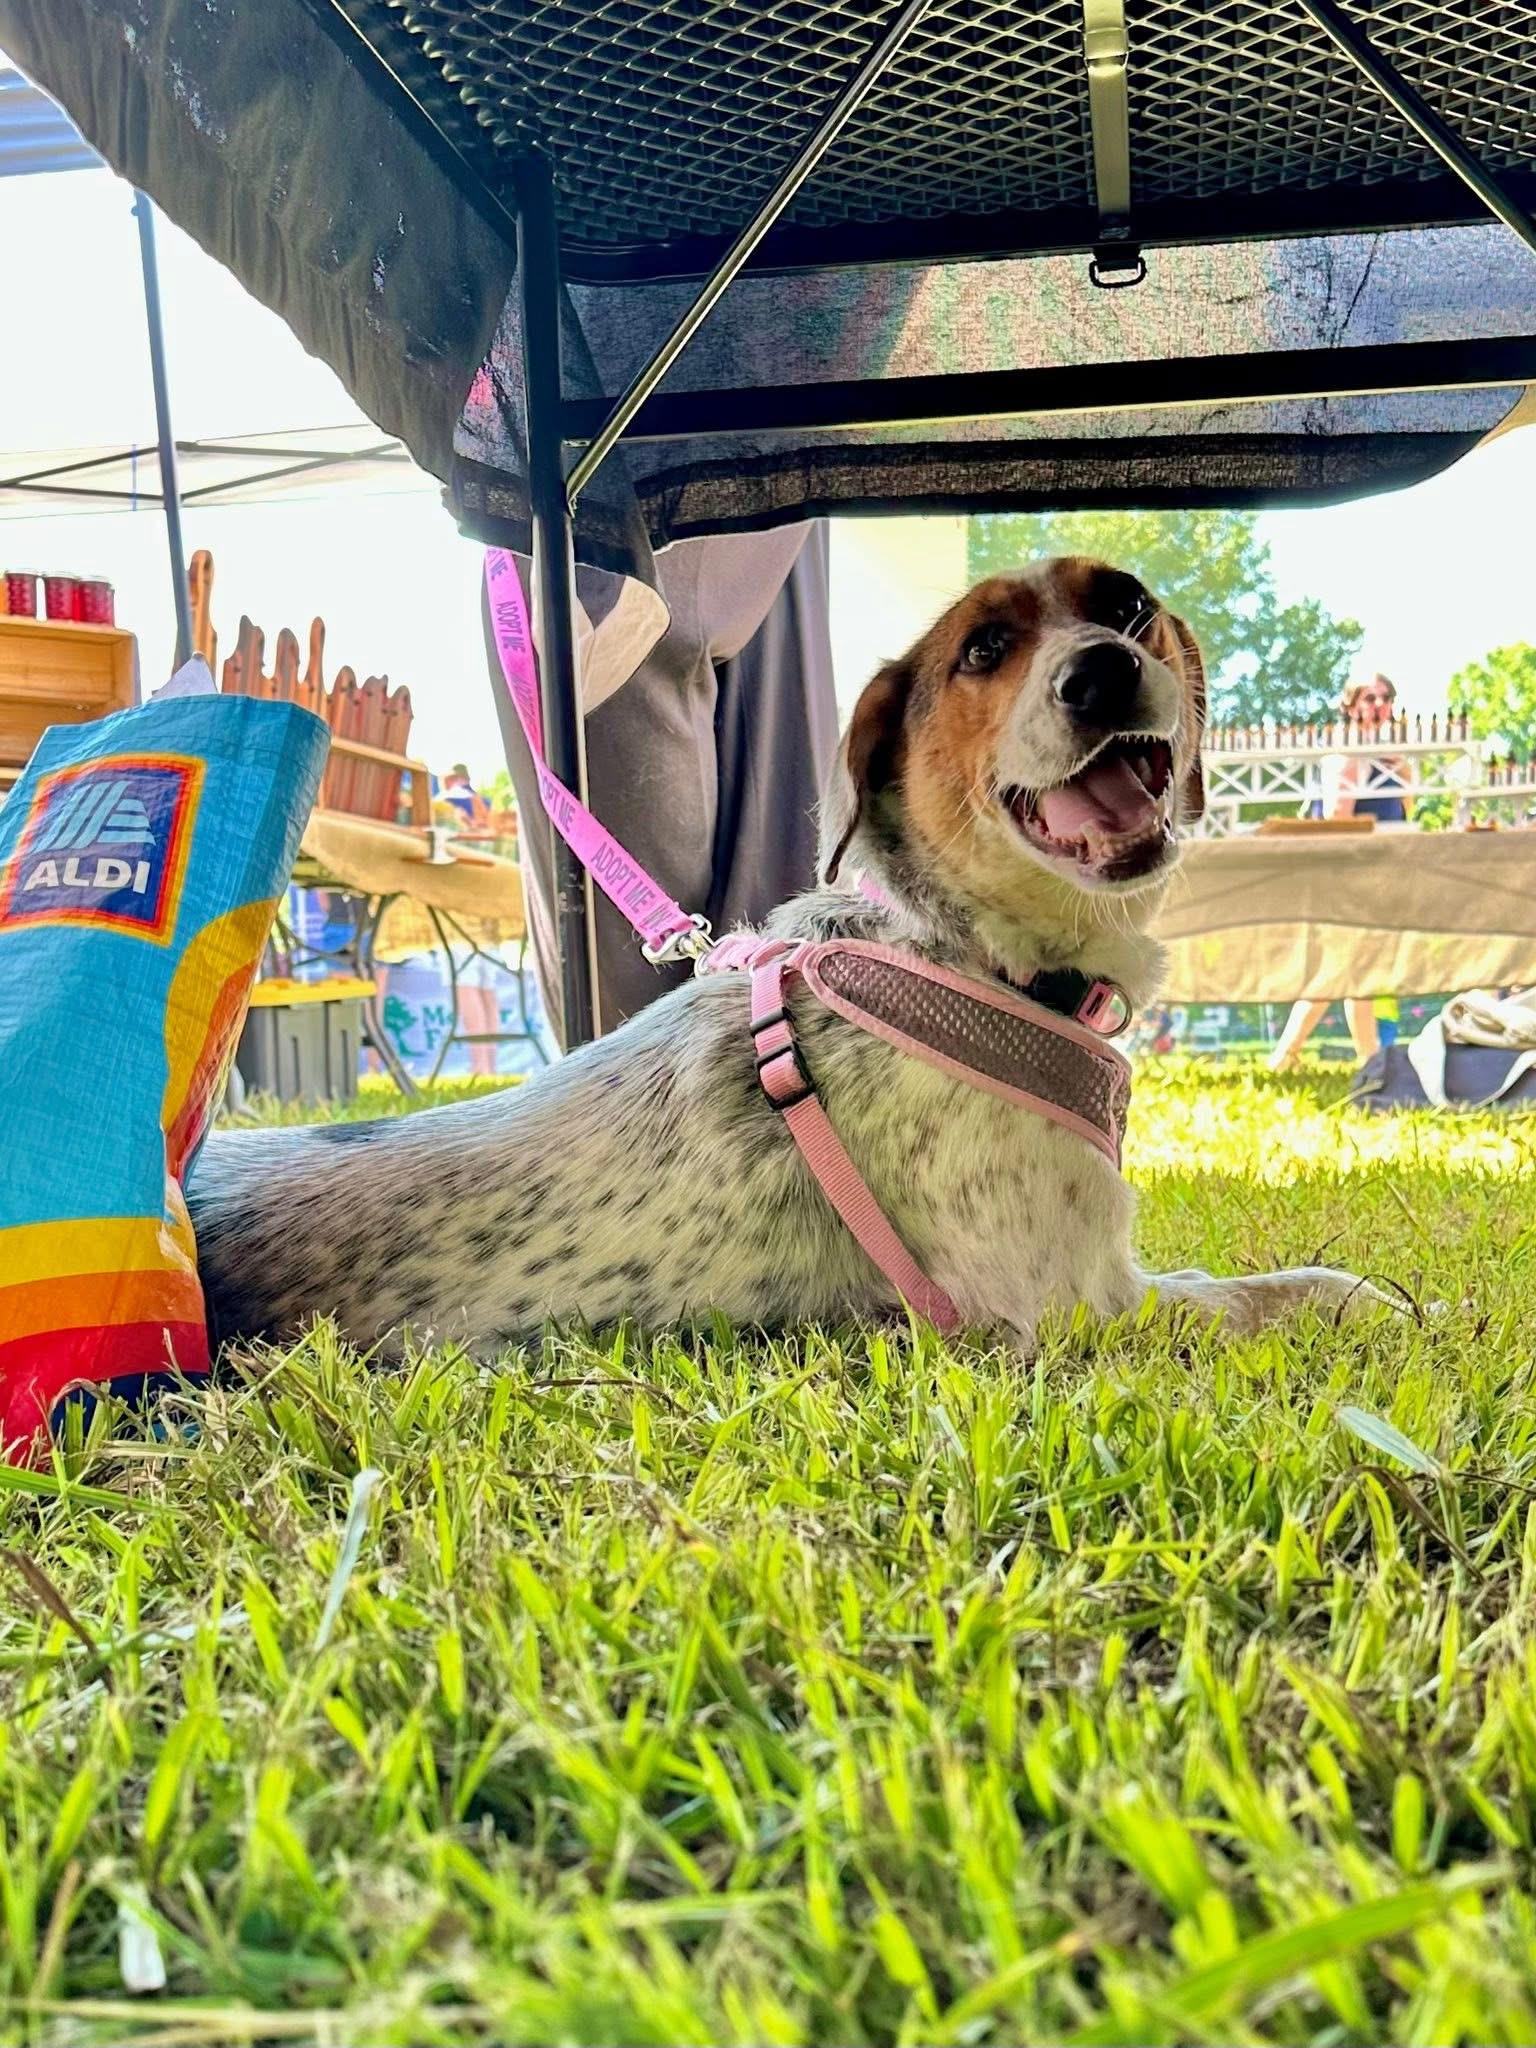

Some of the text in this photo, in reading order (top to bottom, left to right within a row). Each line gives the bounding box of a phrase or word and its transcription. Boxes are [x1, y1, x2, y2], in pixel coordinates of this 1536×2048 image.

[495, 600, 524, 636] ADOPT
[501, 636, 527, 654] ME
[558, 796, 576, 833] ME
[23, 857, 150, 895] ALDI
[590, 841, 657, 914] ADOPT ME
